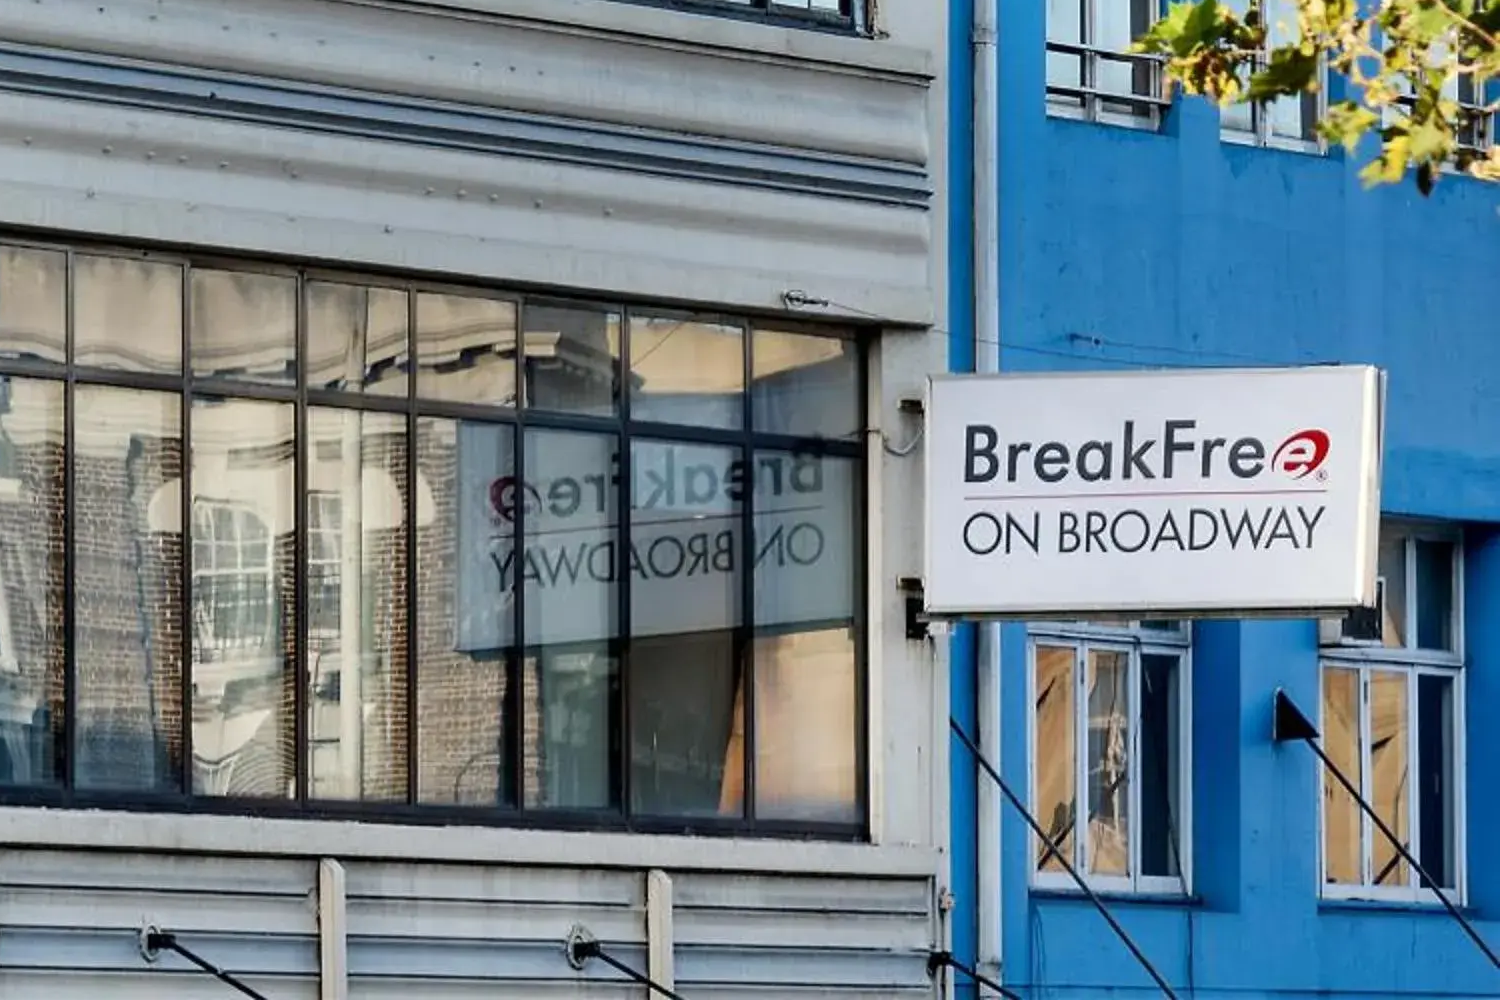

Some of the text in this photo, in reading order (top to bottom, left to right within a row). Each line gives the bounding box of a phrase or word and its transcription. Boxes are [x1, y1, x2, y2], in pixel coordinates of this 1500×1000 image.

[964, 420, 1330, 483] BreakFree
[963, 506, 1326, 555] ON BROADWAY
